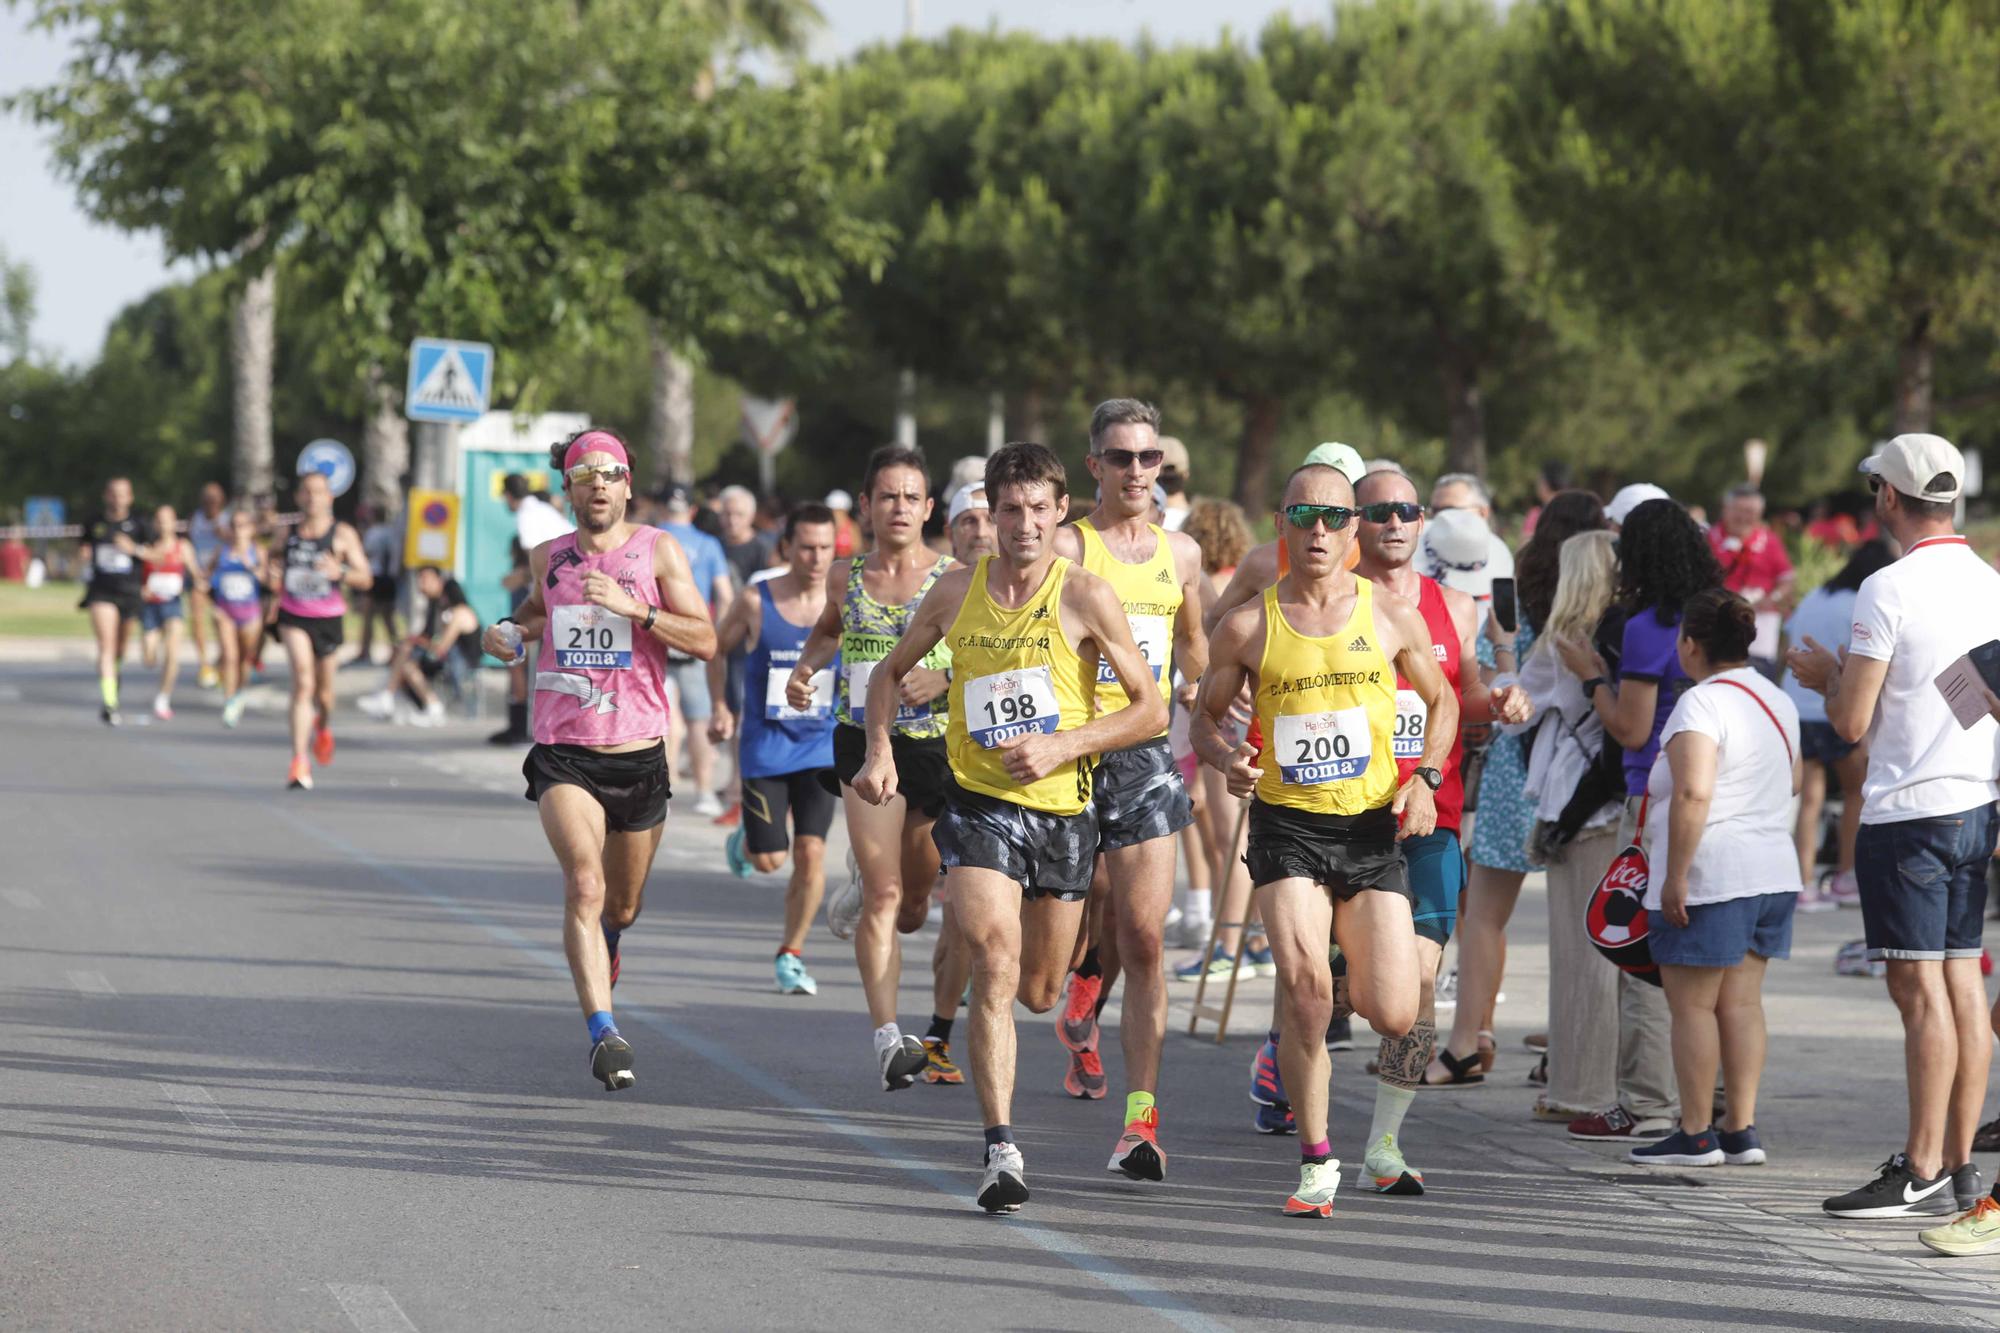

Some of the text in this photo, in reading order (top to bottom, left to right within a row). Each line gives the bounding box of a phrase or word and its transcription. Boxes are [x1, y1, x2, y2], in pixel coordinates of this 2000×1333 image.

[1121, 600, 1166, 616] ÓMETRO
[568, 627, 613, 650] 210
[1036, 637, 1050, 650] 42
[1296, 672, 1366, 691] KILÓMETRO
[1368, 671, 1381, 684] 42
[984, 694, 1037, 725] 198
[1393, 713, 1423, 737] 08
[1295, 734, 1350, 764] 200
[1393, 739, 1424, 753] ma
